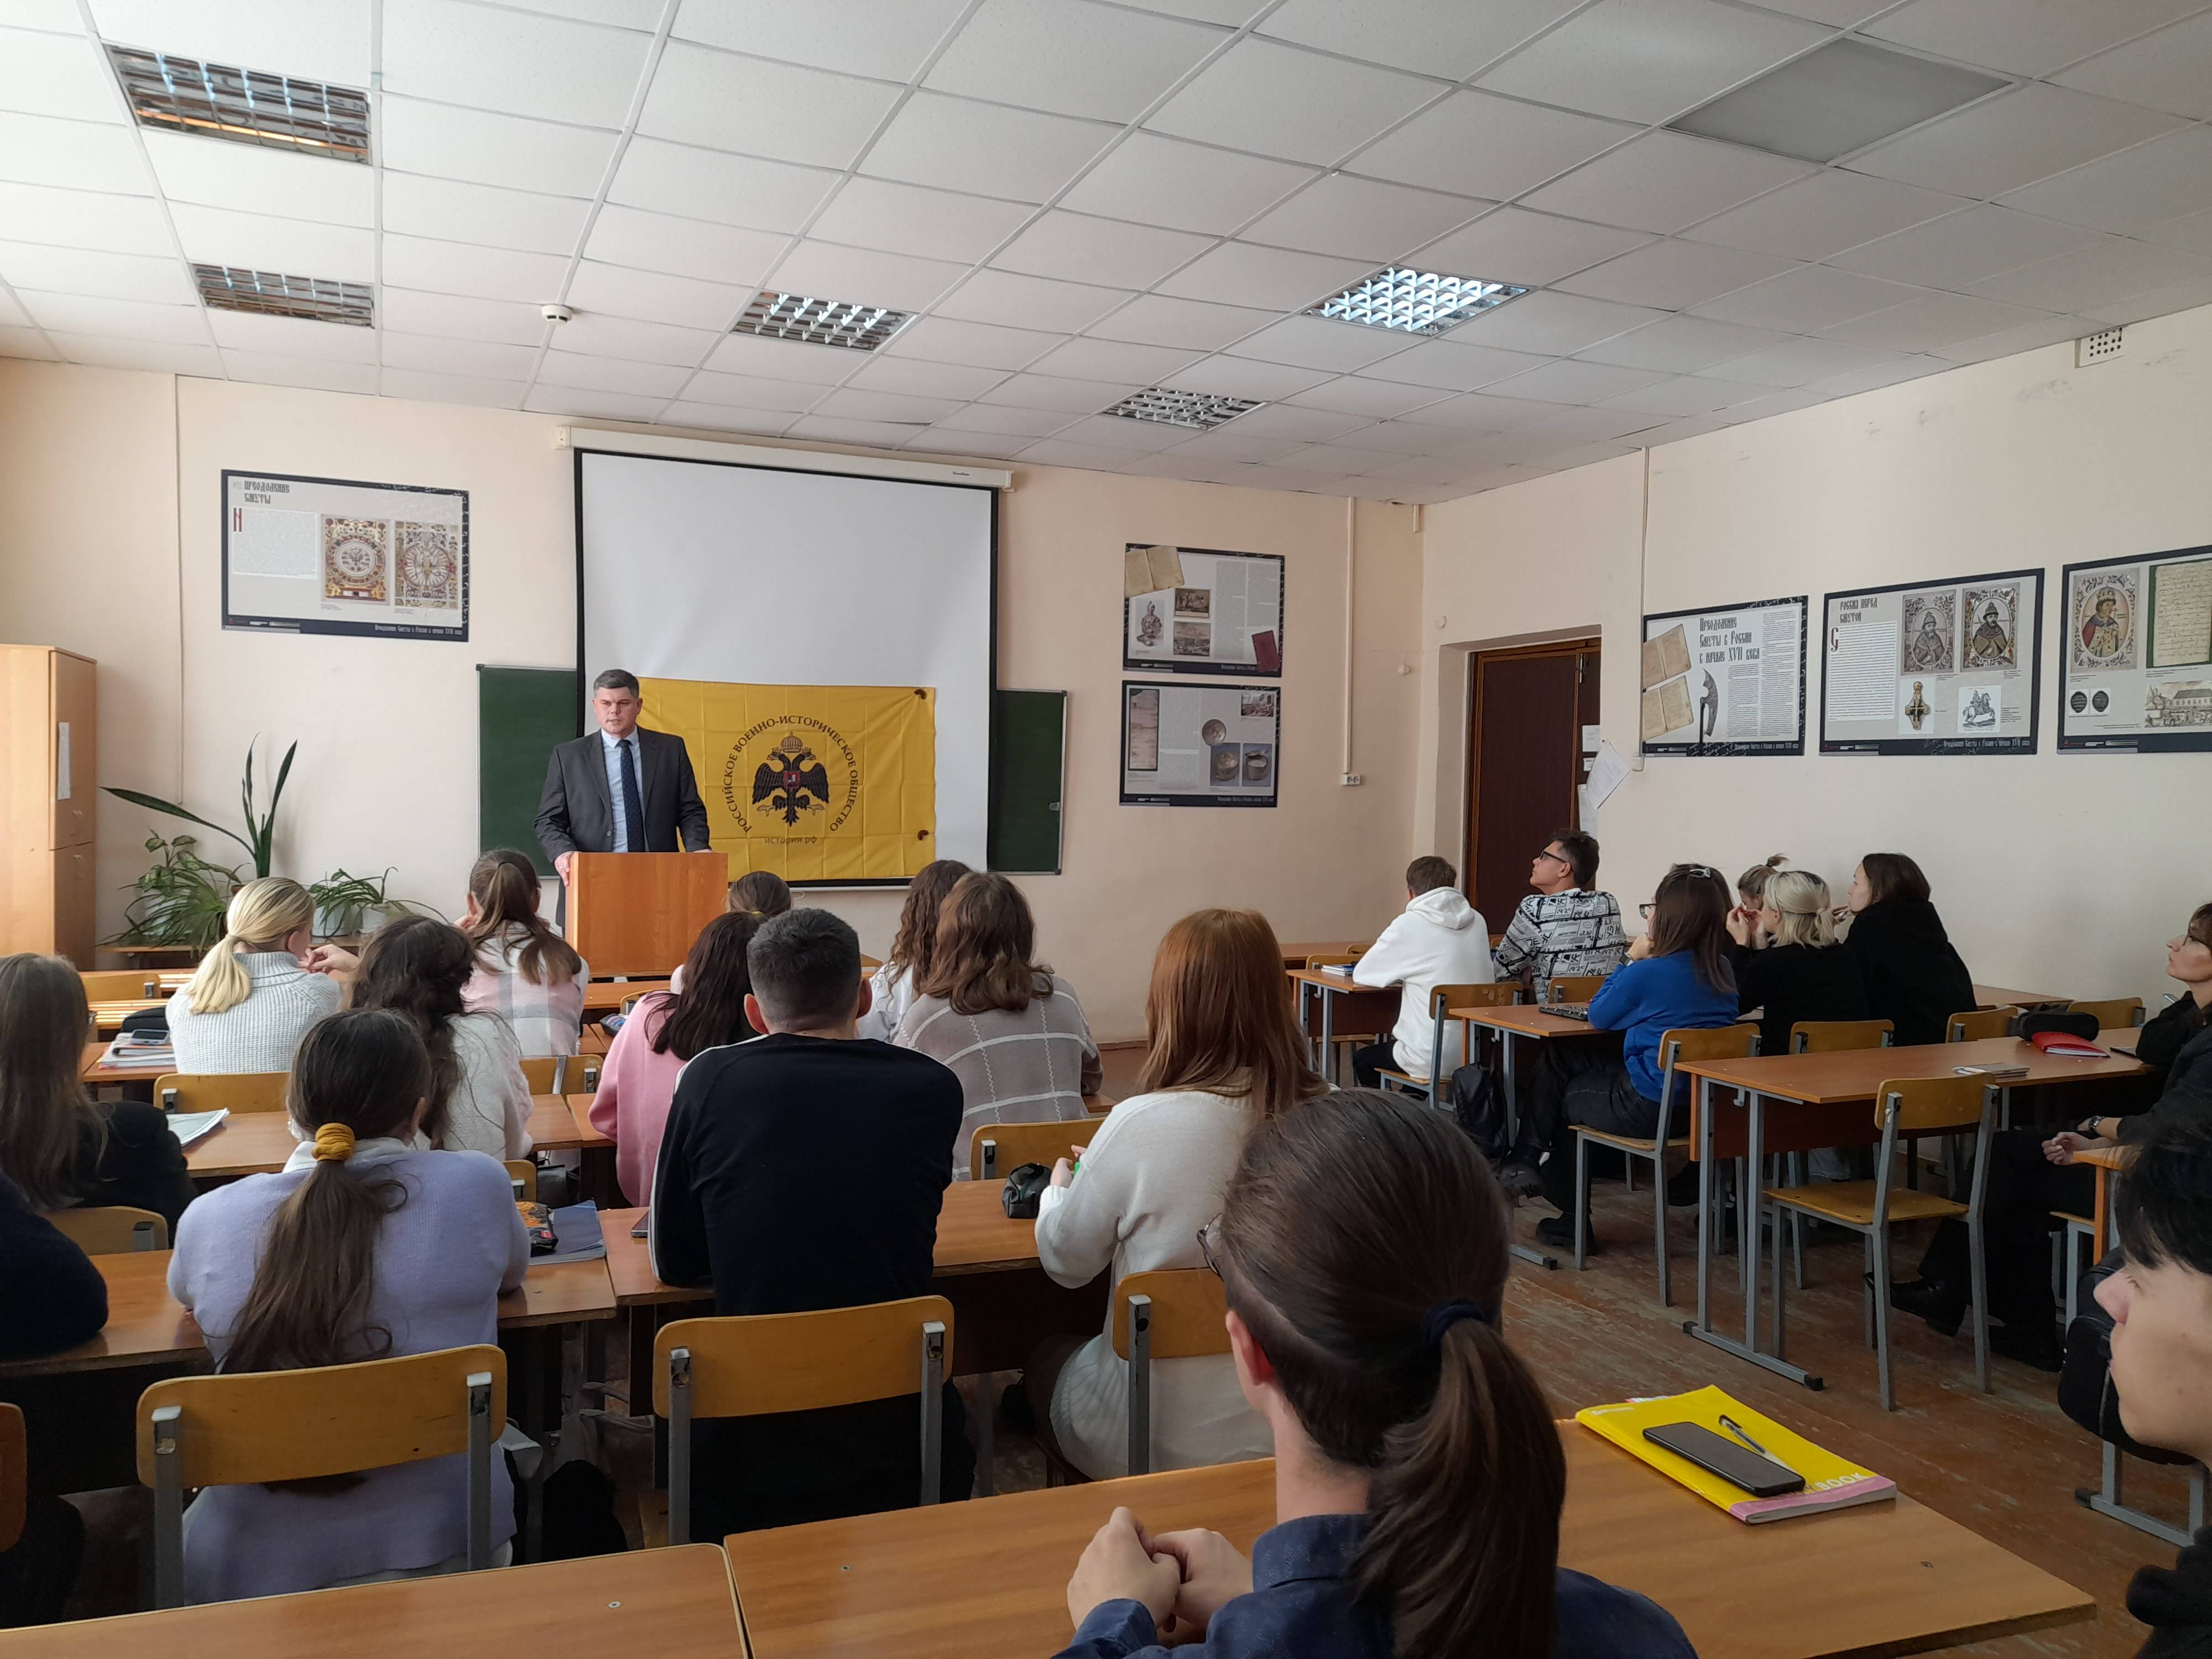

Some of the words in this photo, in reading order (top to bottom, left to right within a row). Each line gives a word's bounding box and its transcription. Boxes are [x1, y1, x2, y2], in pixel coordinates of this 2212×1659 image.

[1728, 646, 1743, 662] XVII
[733, 715, 858, 768] ВОЕННО-ИСТОРИЧЕСКОЕ
[722, 753, 753, 832] РОССИЙСКОЕ
[830, 769, 858, 832] ОБЩЕСТВО
[1814, 1473, 1869, 1490] BOOK
